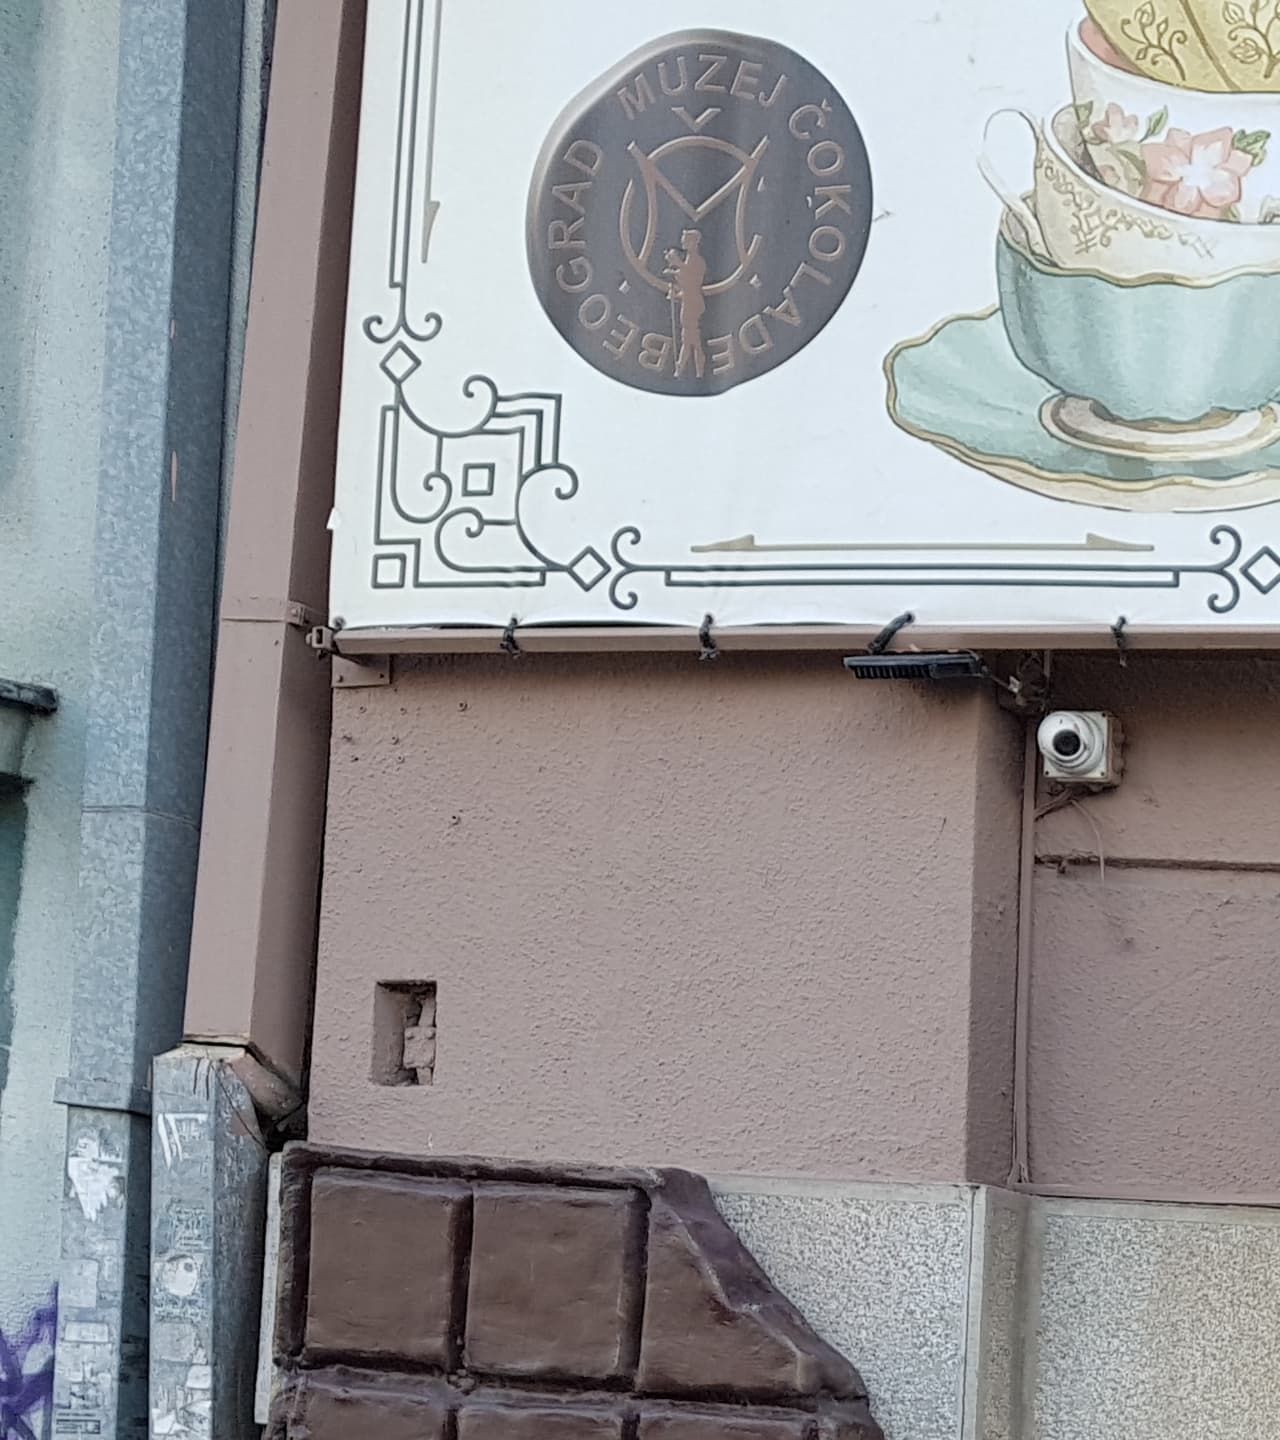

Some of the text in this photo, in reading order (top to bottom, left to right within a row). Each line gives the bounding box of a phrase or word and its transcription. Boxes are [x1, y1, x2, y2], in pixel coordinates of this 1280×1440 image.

[547, 138, 674, 374] BEOGRAD
[616, 53, 854, 377] MUZEJ ČOKOLADE
